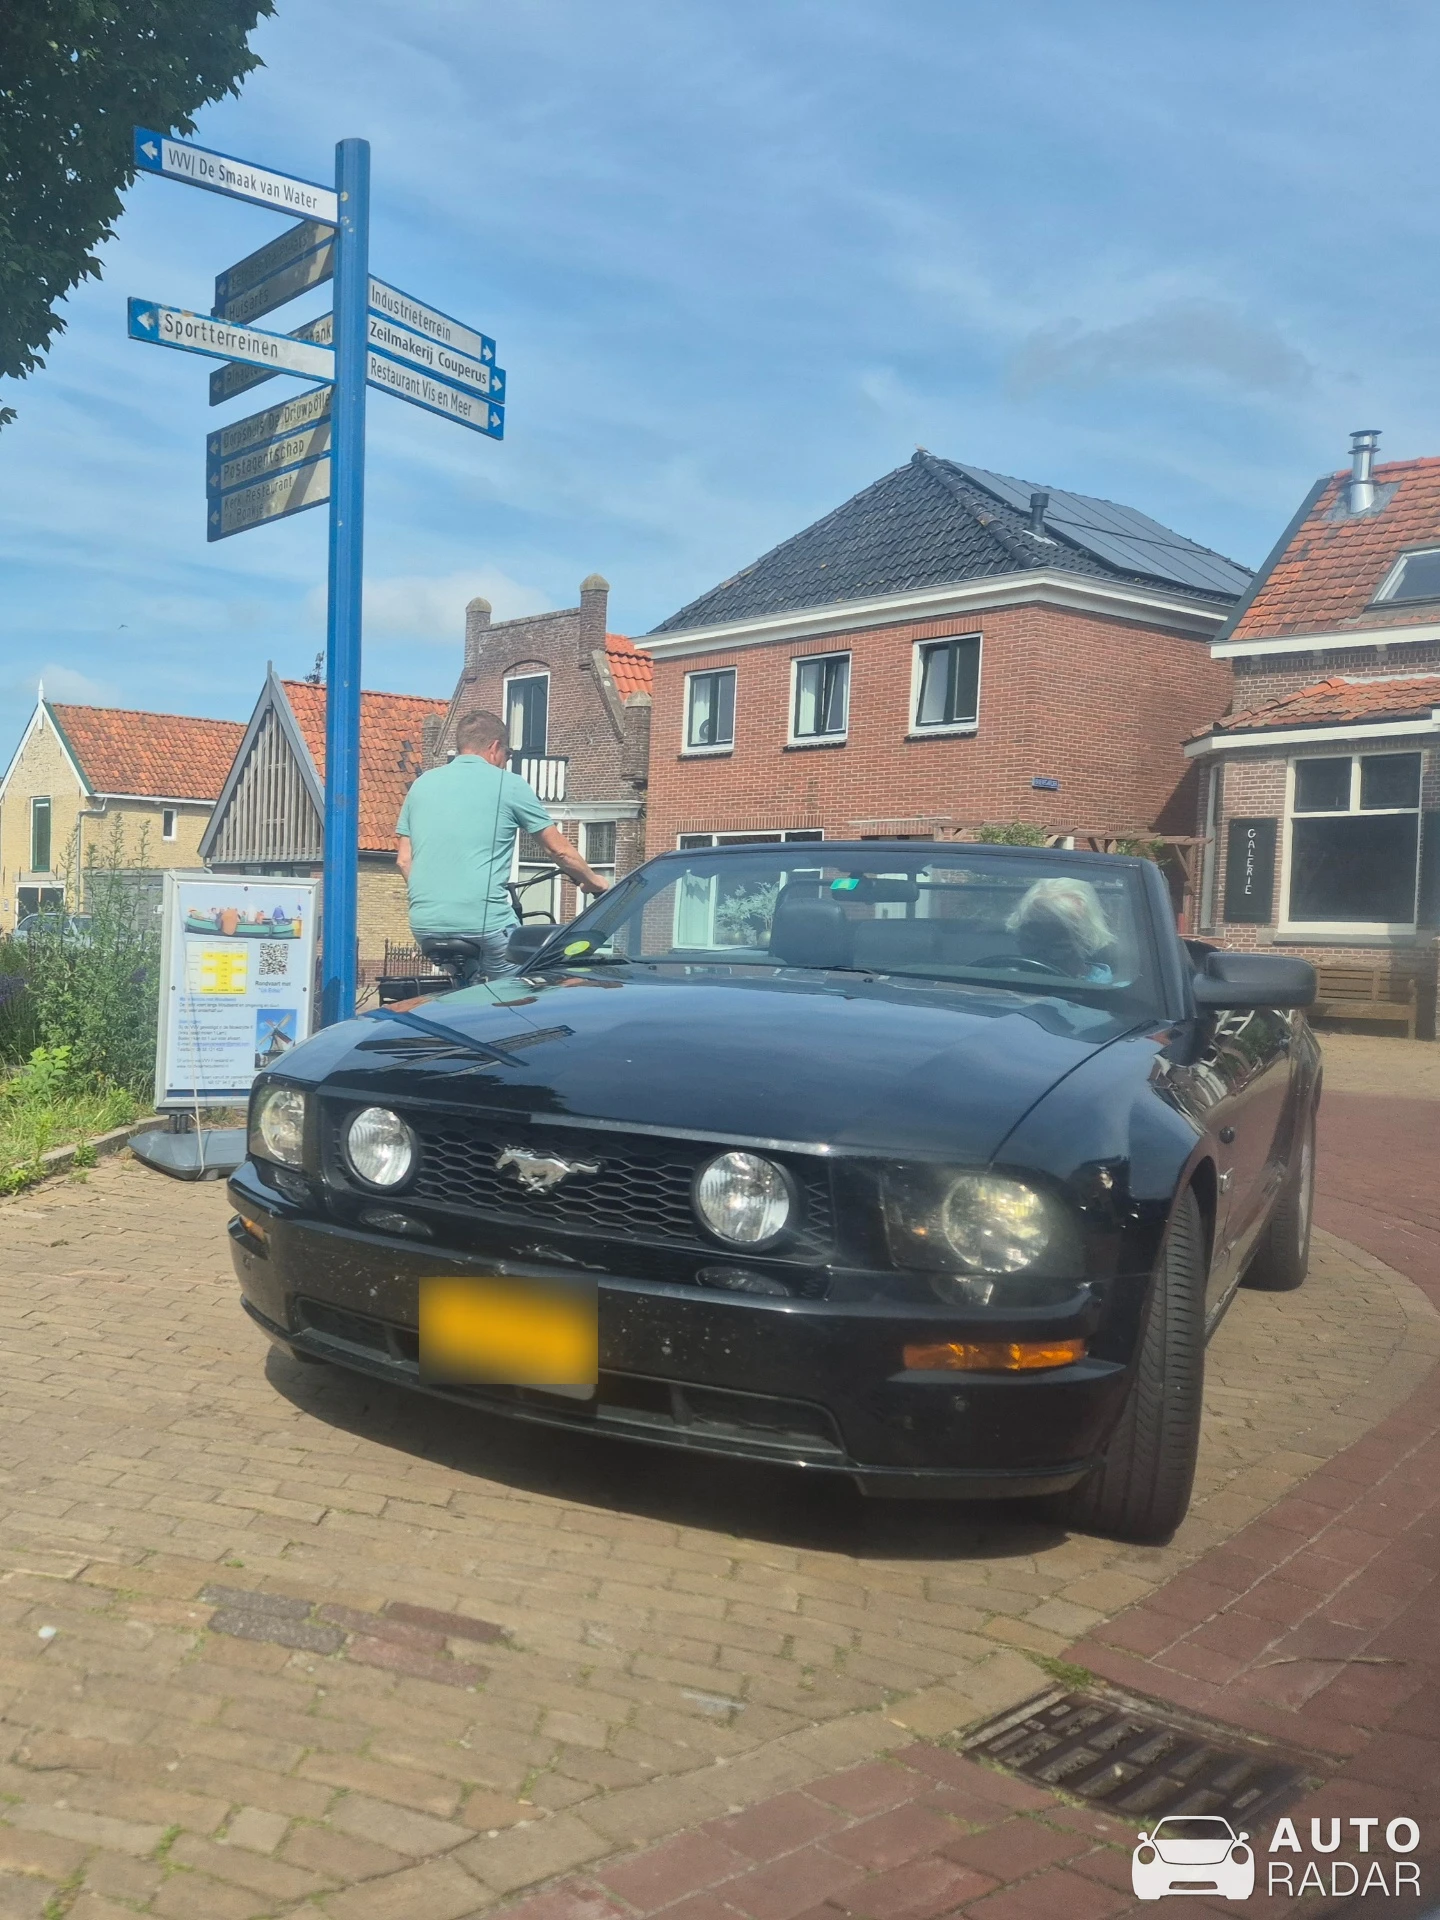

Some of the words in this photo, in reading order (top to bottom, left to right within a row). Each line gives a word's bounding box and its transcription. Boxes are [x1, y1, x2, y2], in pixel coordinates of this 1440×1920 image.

[199, 158, 215, 179] De
[219, 164, 257, 192] Smaak
[260, 181, 280, 199] van
[283, 184, 318, 210] Water
[229, 288, 269, 319] Huisarts
[371, 285, 451, 342] Industrieterrein
[165, 313, 278, 358] Sportterreinen
[370, 321, 434, 365] Zeilmakerij
[438, 352, 487, 385] Couperus
[371, 357, 421, 388] Restaurant
[422, 380, 435, 402] Vis
[438, 390, 448, 407] en
[451, 392, 472, 417] Meer
[268, 413, 280, 430] De
[223, 439, 304, 482] Postagentschap
[246, 474, 293, 501] Restaurant
[1244, 828, 1257, 895] GALERIE
